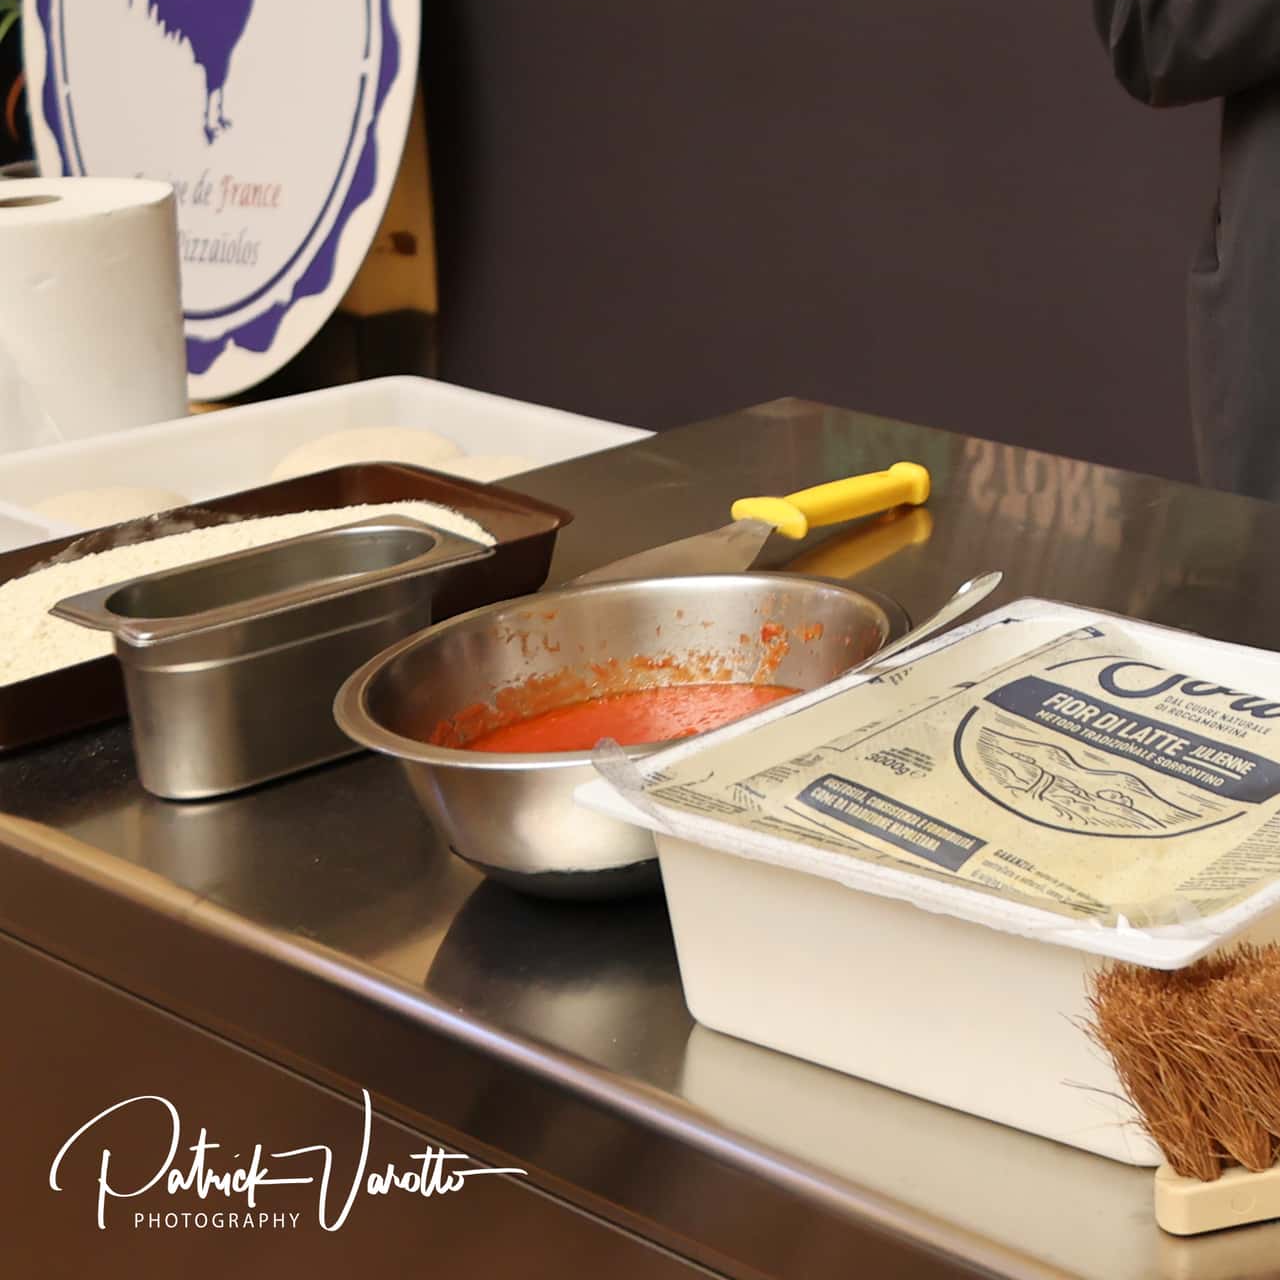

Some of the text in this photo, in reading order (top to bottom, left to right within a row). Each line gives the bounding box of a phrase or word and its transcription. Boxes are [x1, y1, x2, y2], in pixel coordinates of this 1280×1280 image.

[193, 168, 213, 206] de
[216, 175, 282, 214] France
[1034, 709, 1225, 787] METODO TRADIZIONALE SORRENTINO
[1042, 692, 1256, 775] FIOR DI LATTE JULIENNE
